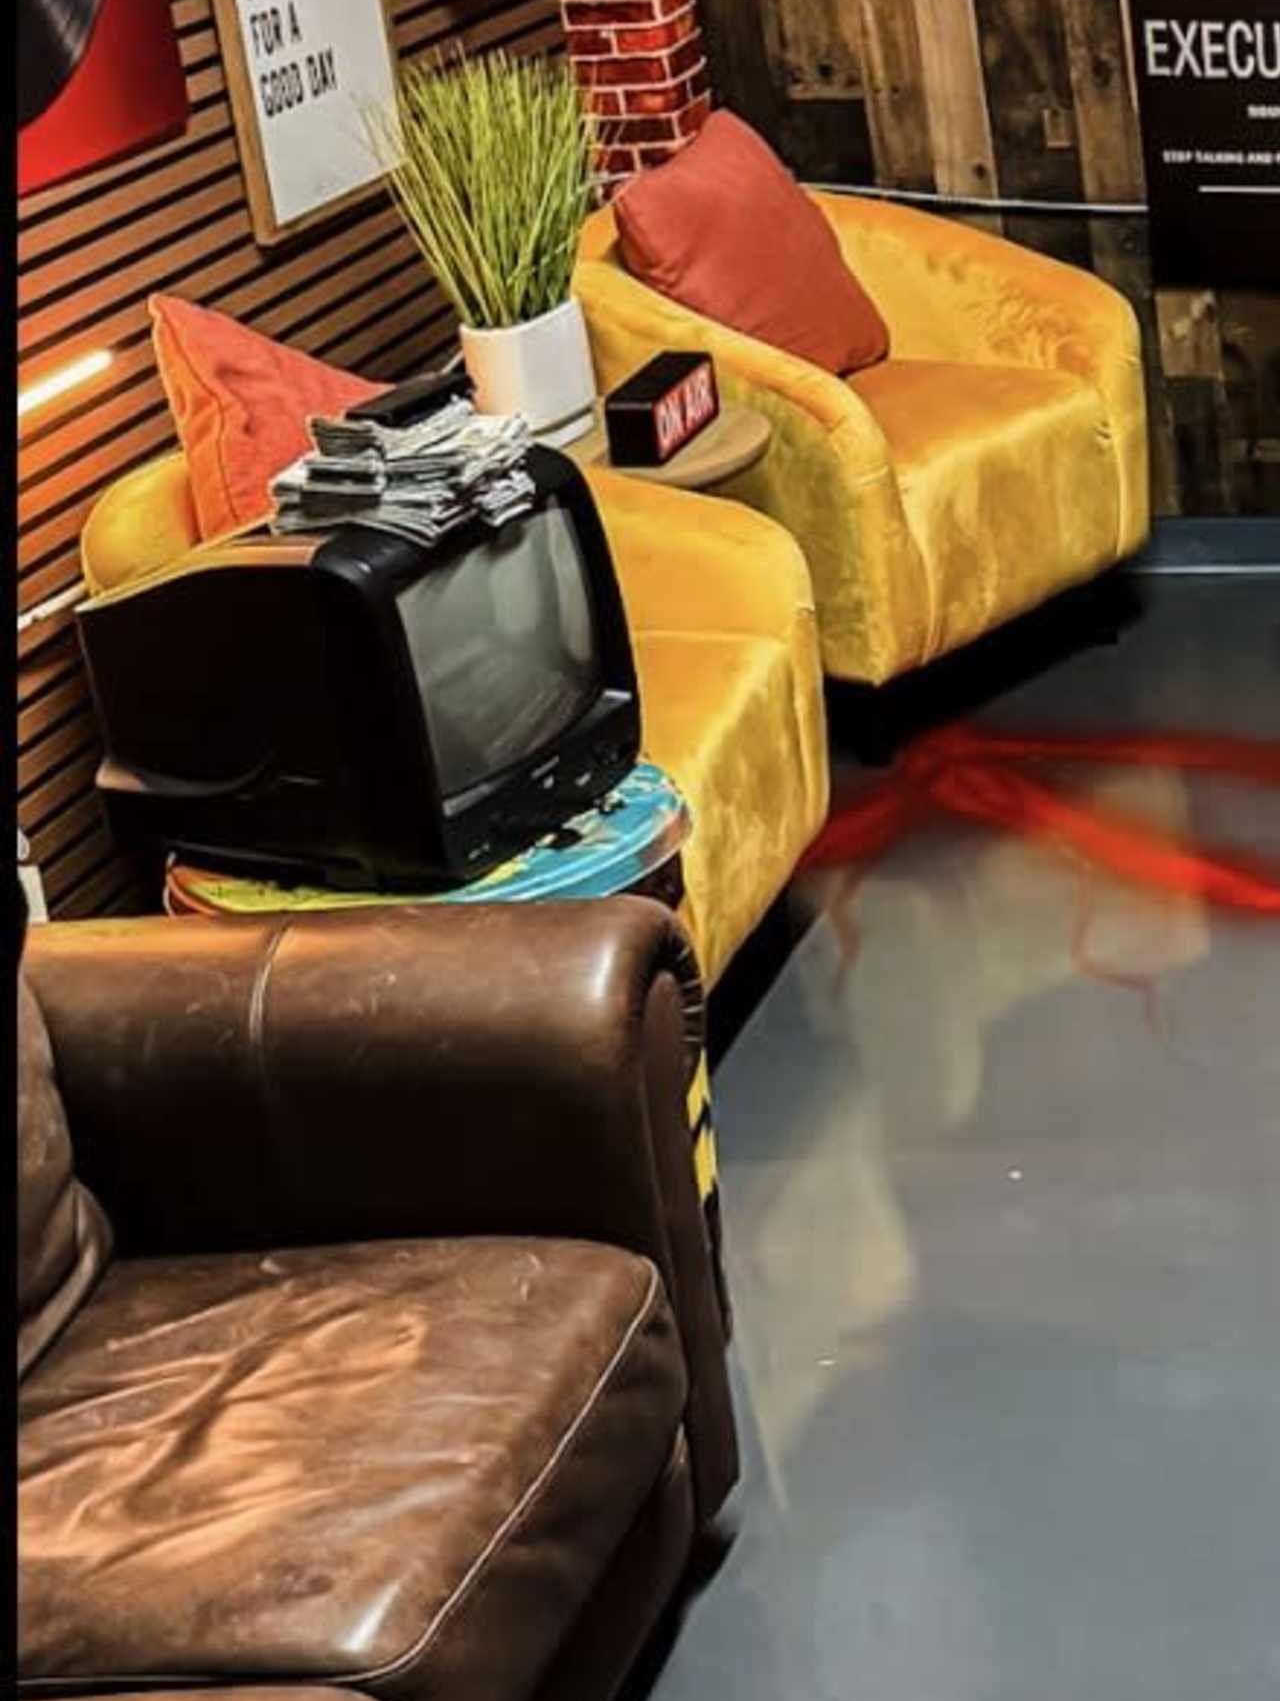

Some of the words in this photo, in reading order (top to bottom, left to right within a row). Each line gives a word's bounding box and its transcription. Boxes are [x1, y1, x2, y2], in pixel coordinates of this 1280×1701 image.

[249, 6, 285, 58] FOR
[288, 0, 303, 44] A
[259, 60, 305, 118] GOOD
[305, 45, 340, 98] DAY
